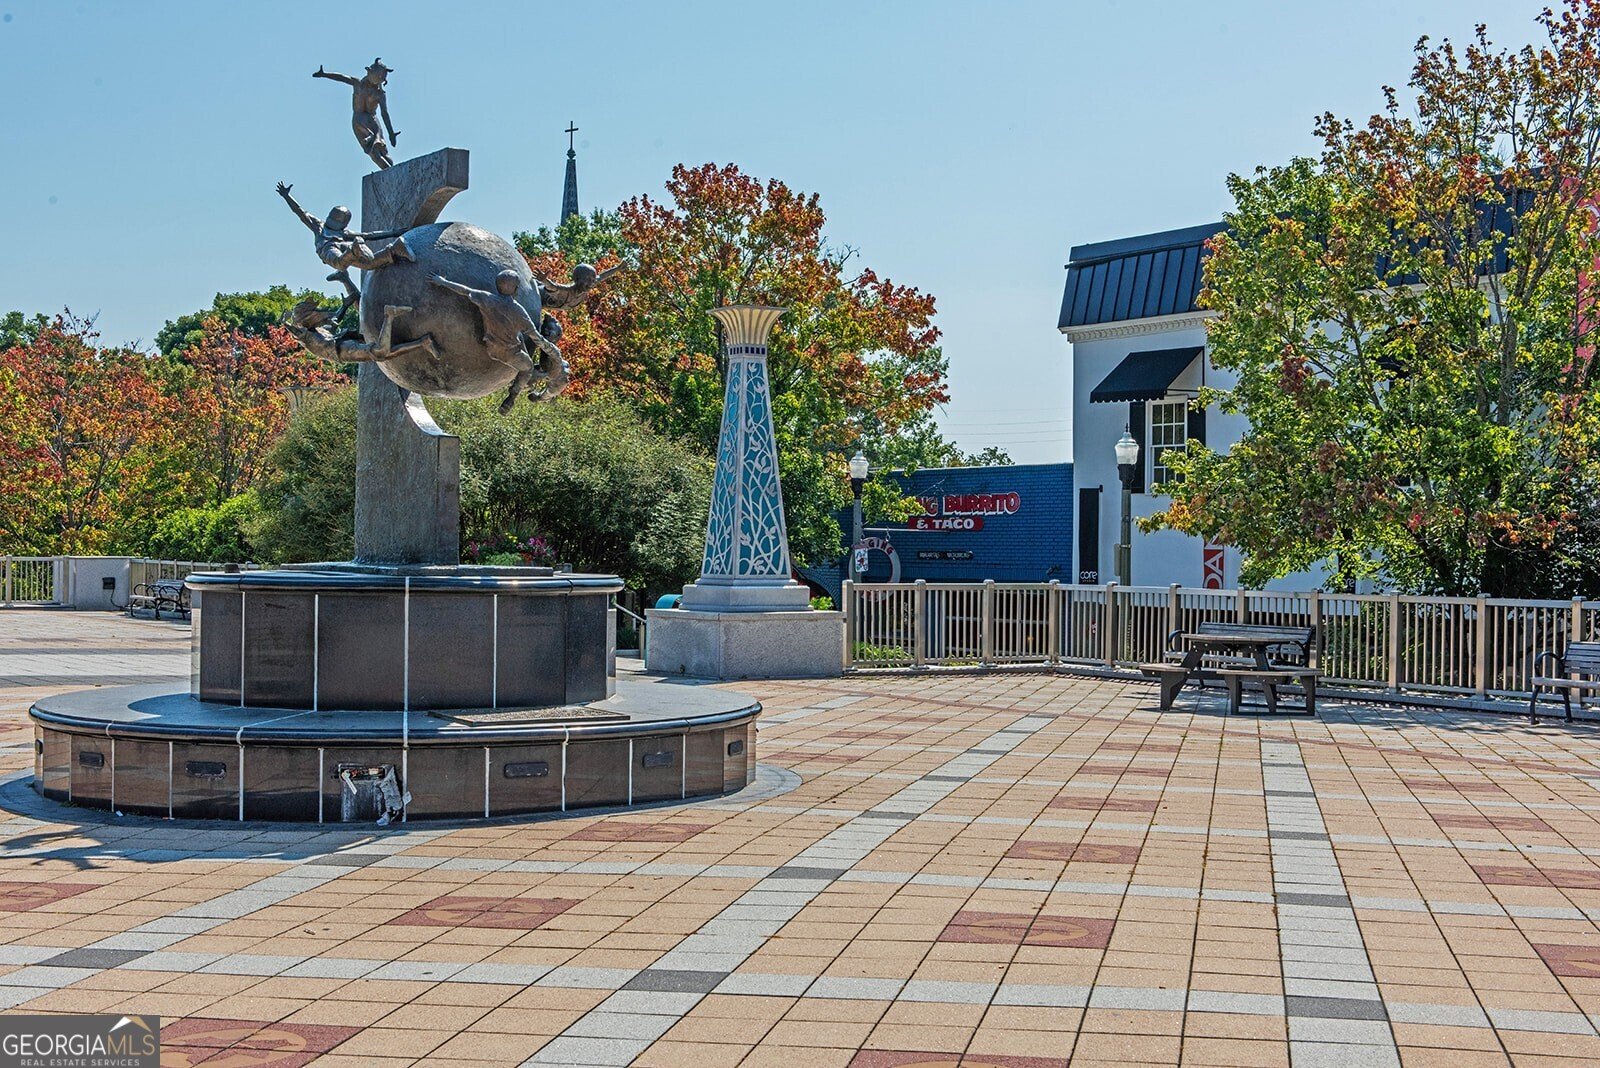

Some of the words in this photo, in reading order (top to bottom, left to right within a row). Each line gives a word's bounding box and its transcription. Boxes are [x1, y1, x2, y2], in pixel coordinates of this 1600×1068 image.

[943, 491, 1020, 516] BURRITO
[916, 519, 928, 529] &
[932, 518, 974, 529] TACO
[1080, 571, 1098, 580] core
